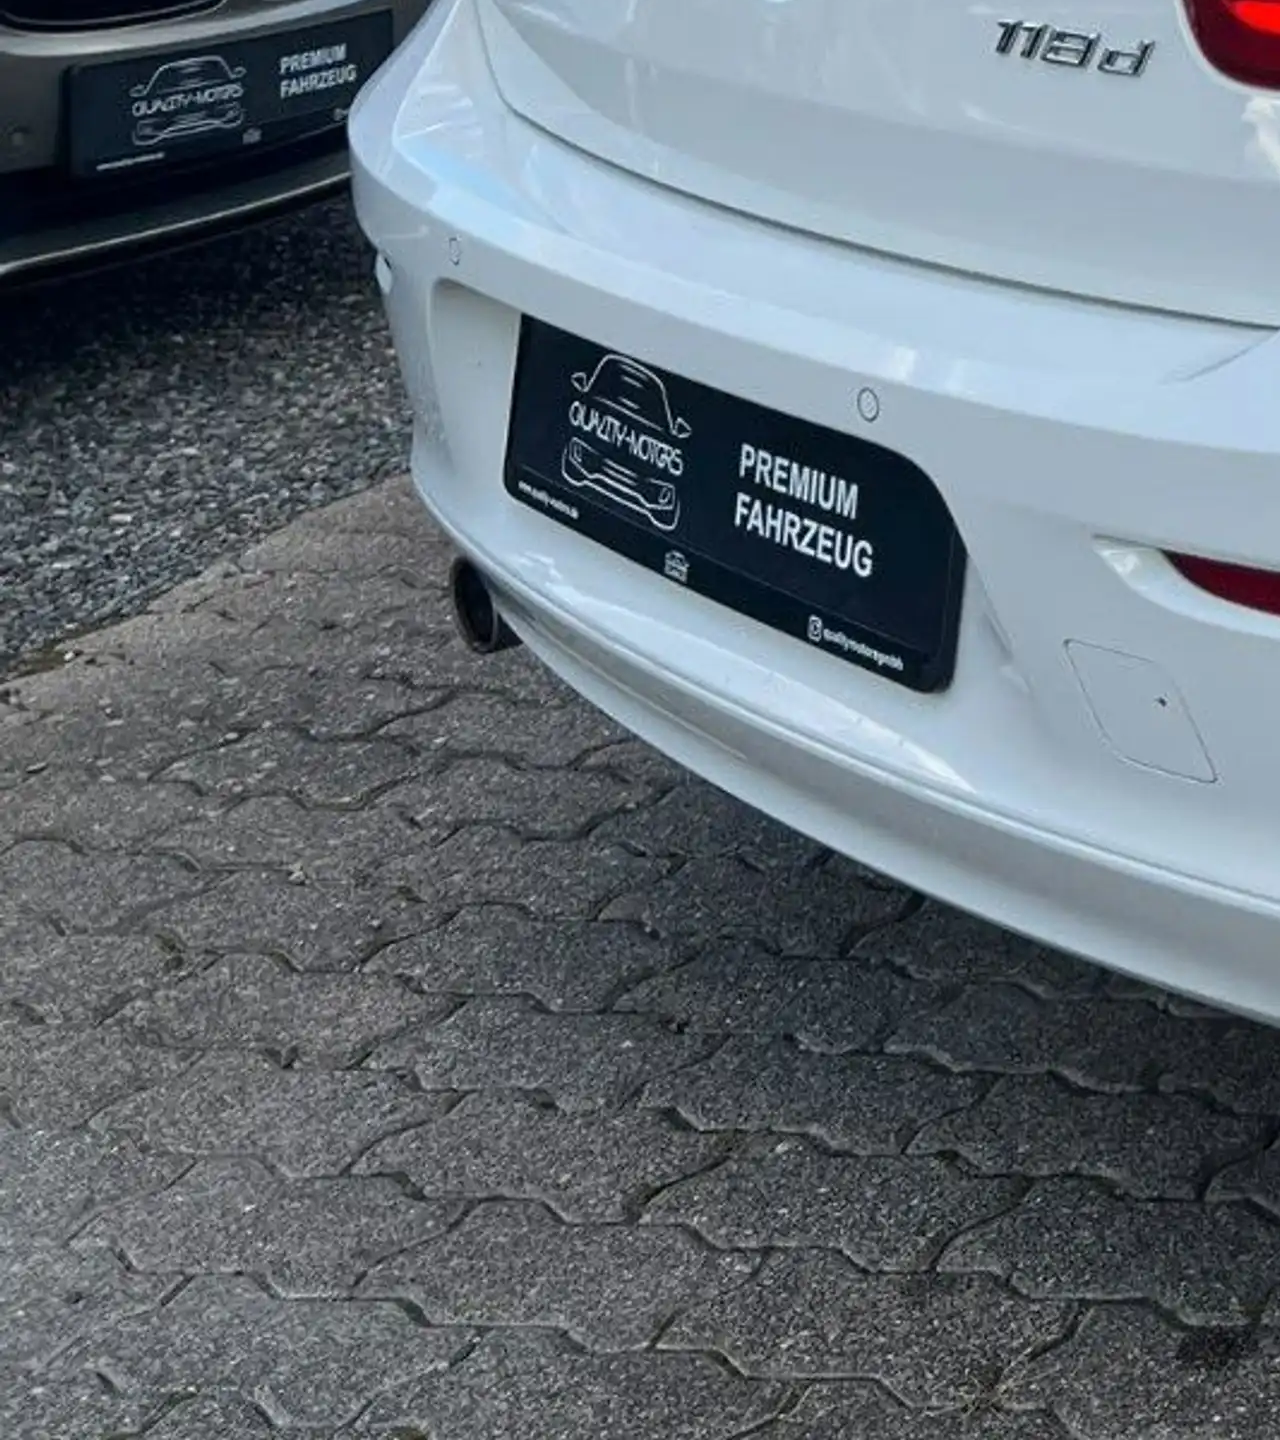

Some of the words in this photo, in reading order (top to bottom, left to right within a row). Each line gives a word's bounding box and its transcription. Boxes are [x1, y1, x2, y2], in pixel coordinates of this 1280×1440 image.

[279, 43, 346, 74] PREMIUM
[996, 20, 1156, 78] 118d
[280, 64, 357, 98] FAHRZEUG
[739, 442, 859, 520] PREMIUM
[734, 491, 873, 578] FAHRZEUG
